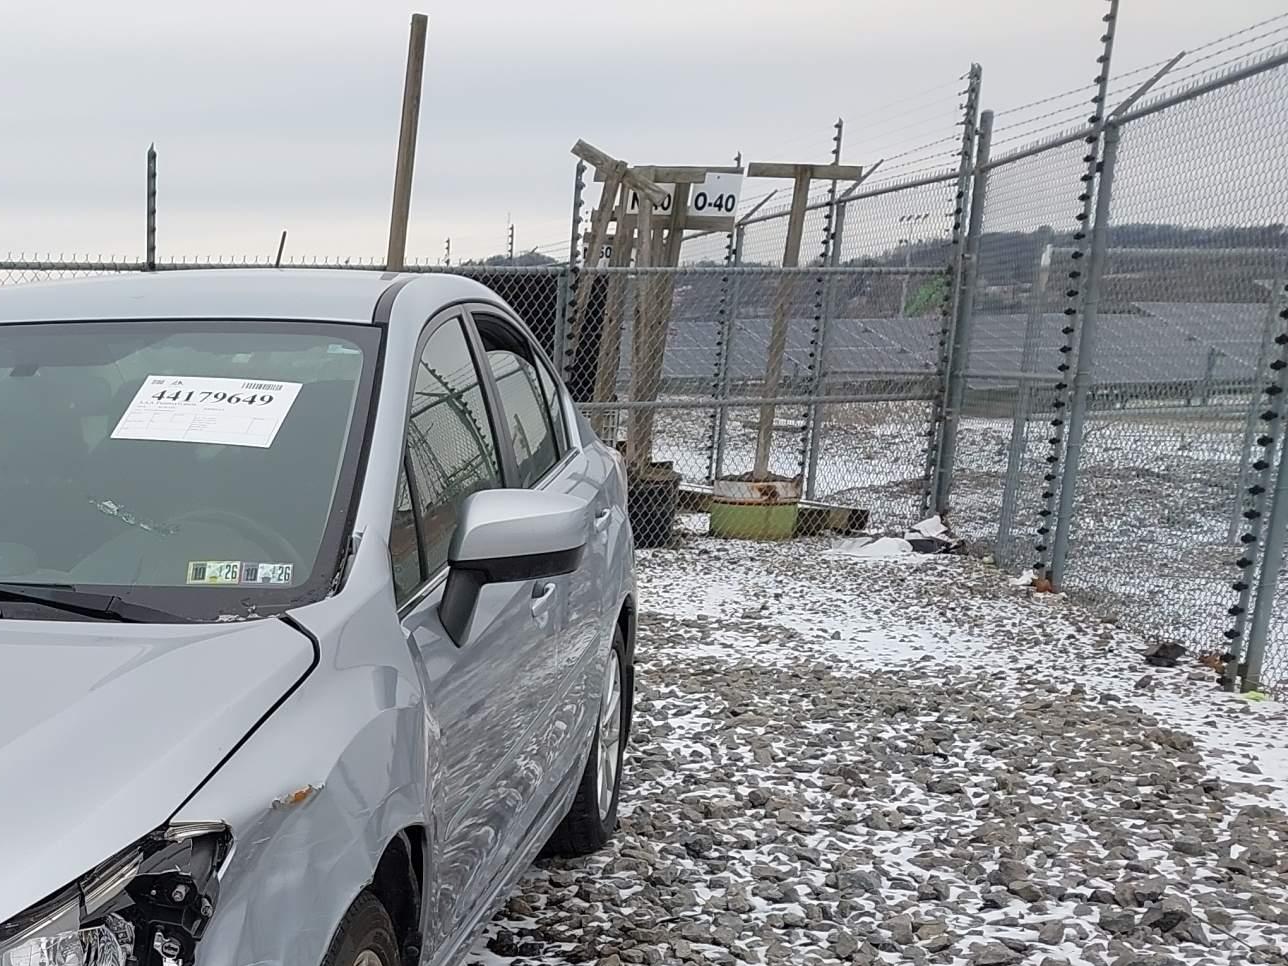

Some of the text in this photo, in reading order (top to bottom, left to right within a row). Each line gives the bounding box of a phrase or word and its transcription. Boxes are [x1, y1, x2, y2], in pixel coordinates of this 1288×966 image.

[694, 191, 736, 212] O-40
[151, 389, 274, 406] 44179649
[224, 564, 238, 580] 26
[277, 566, 291, 581] 26
